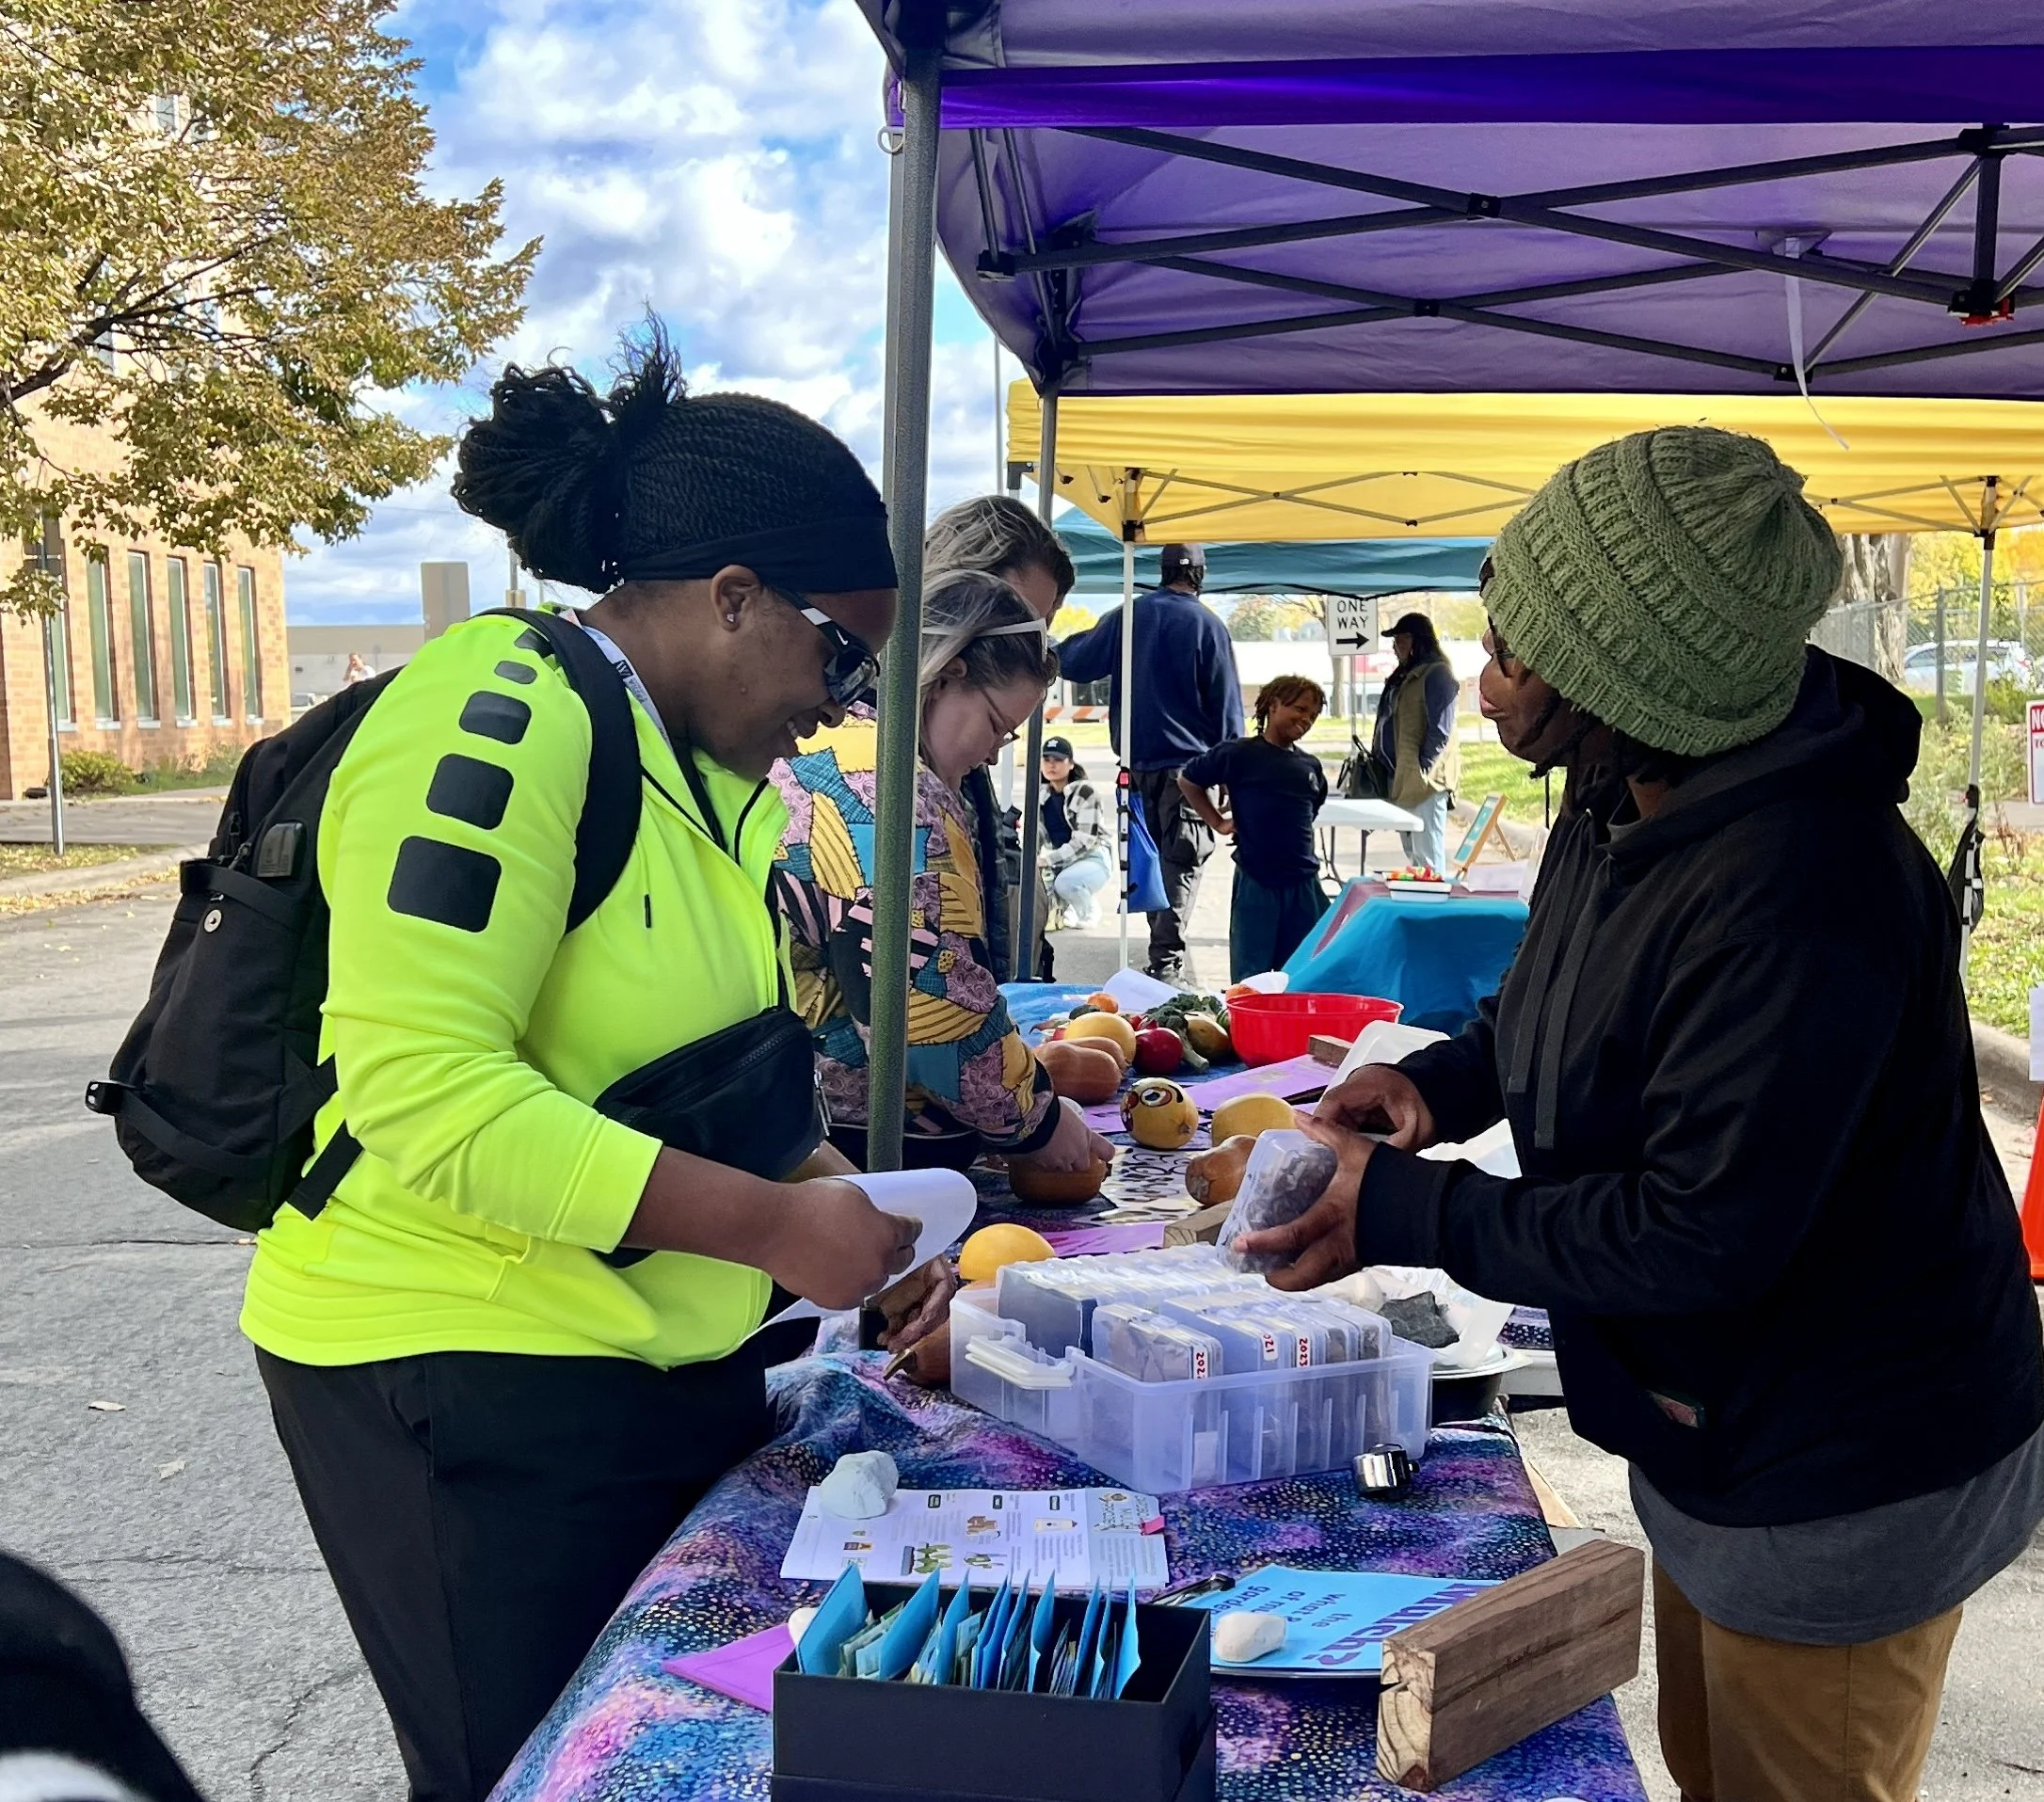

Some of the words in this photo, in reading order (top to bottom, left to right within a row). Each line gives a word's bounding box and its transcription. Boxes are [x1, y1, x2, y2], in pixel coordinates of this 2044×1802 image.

[1336, 599, 1367, 614] ONE
[1337, 615, 1368, 630] WAY
[1299, 1337, 1308, 1367] 2023
[1279, 1590, 1306, 1603] of
[1291, 1594, 1347, 1616] what
[1311, 1613, 1353, 1629] the
